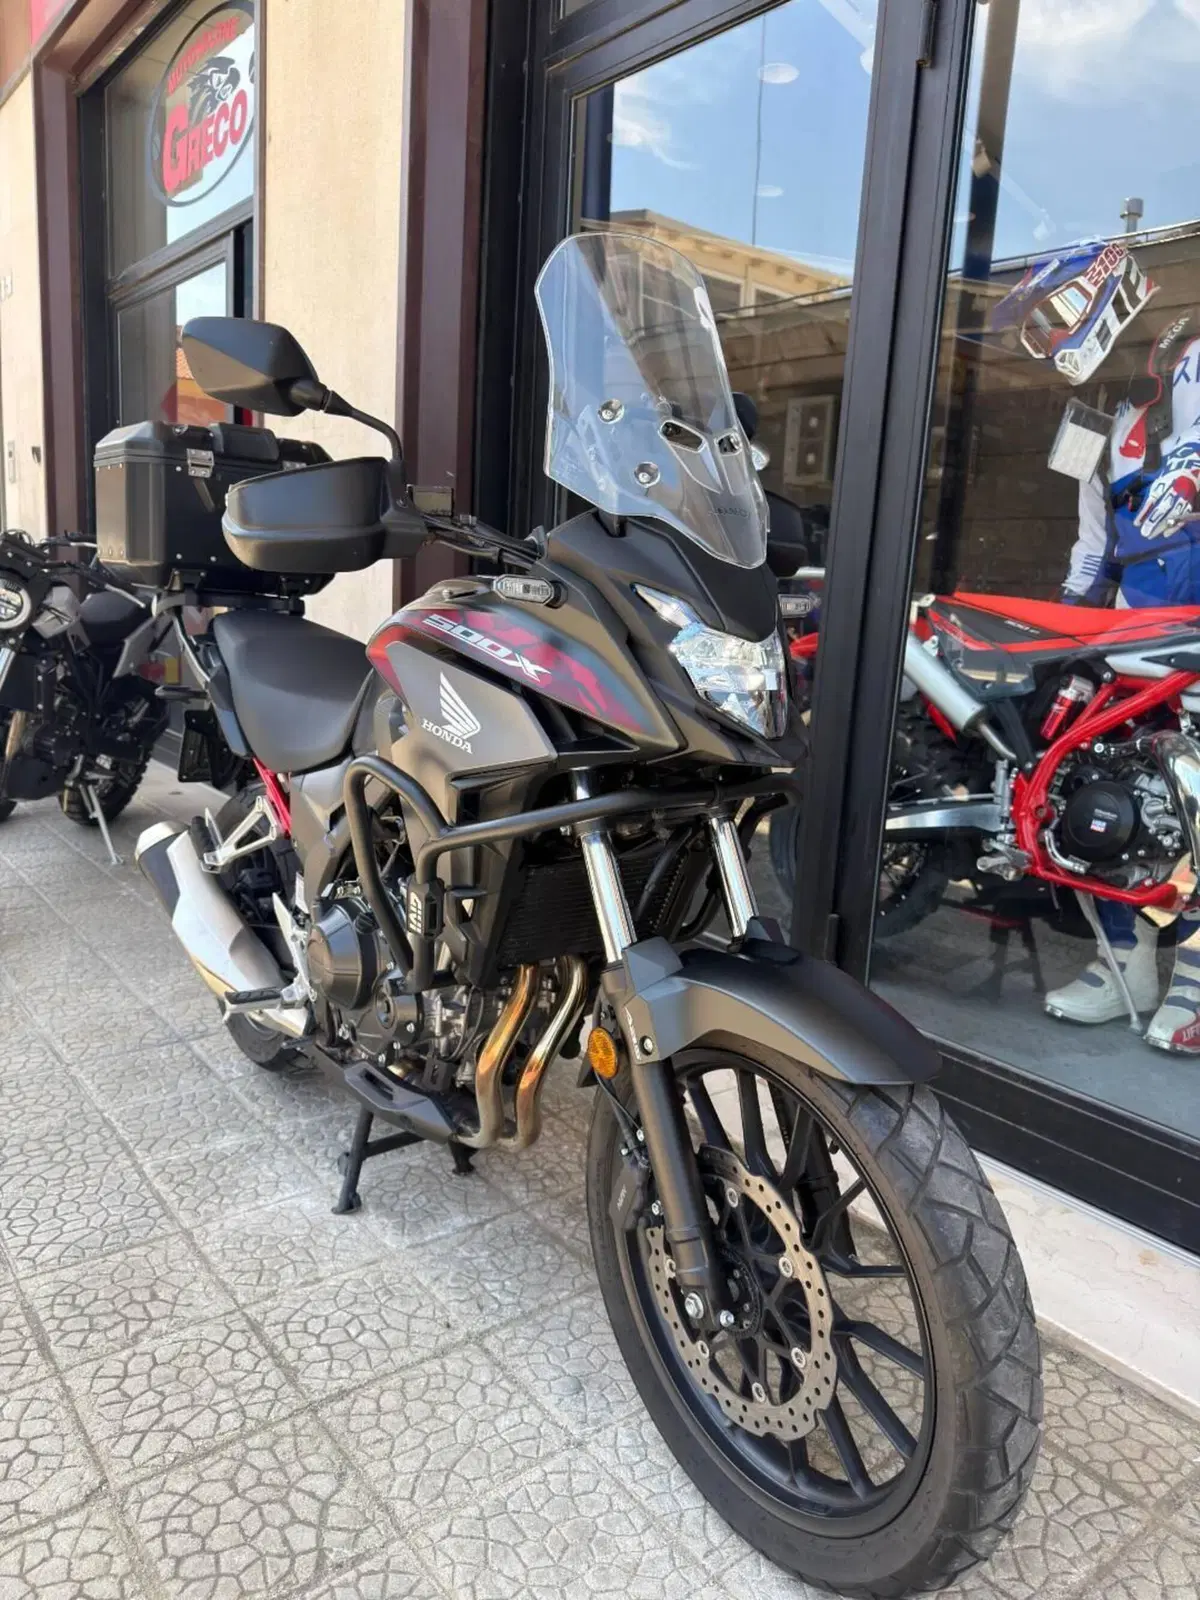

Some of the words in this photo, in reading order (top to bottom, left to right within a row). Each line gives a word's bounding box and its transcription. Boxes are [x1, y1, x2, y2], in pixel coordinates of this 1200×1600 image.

[163, 89, 247, 192] GRECO
[422, 613, 551, 682] 500X
[421, 718, 473, 754] HONDA
